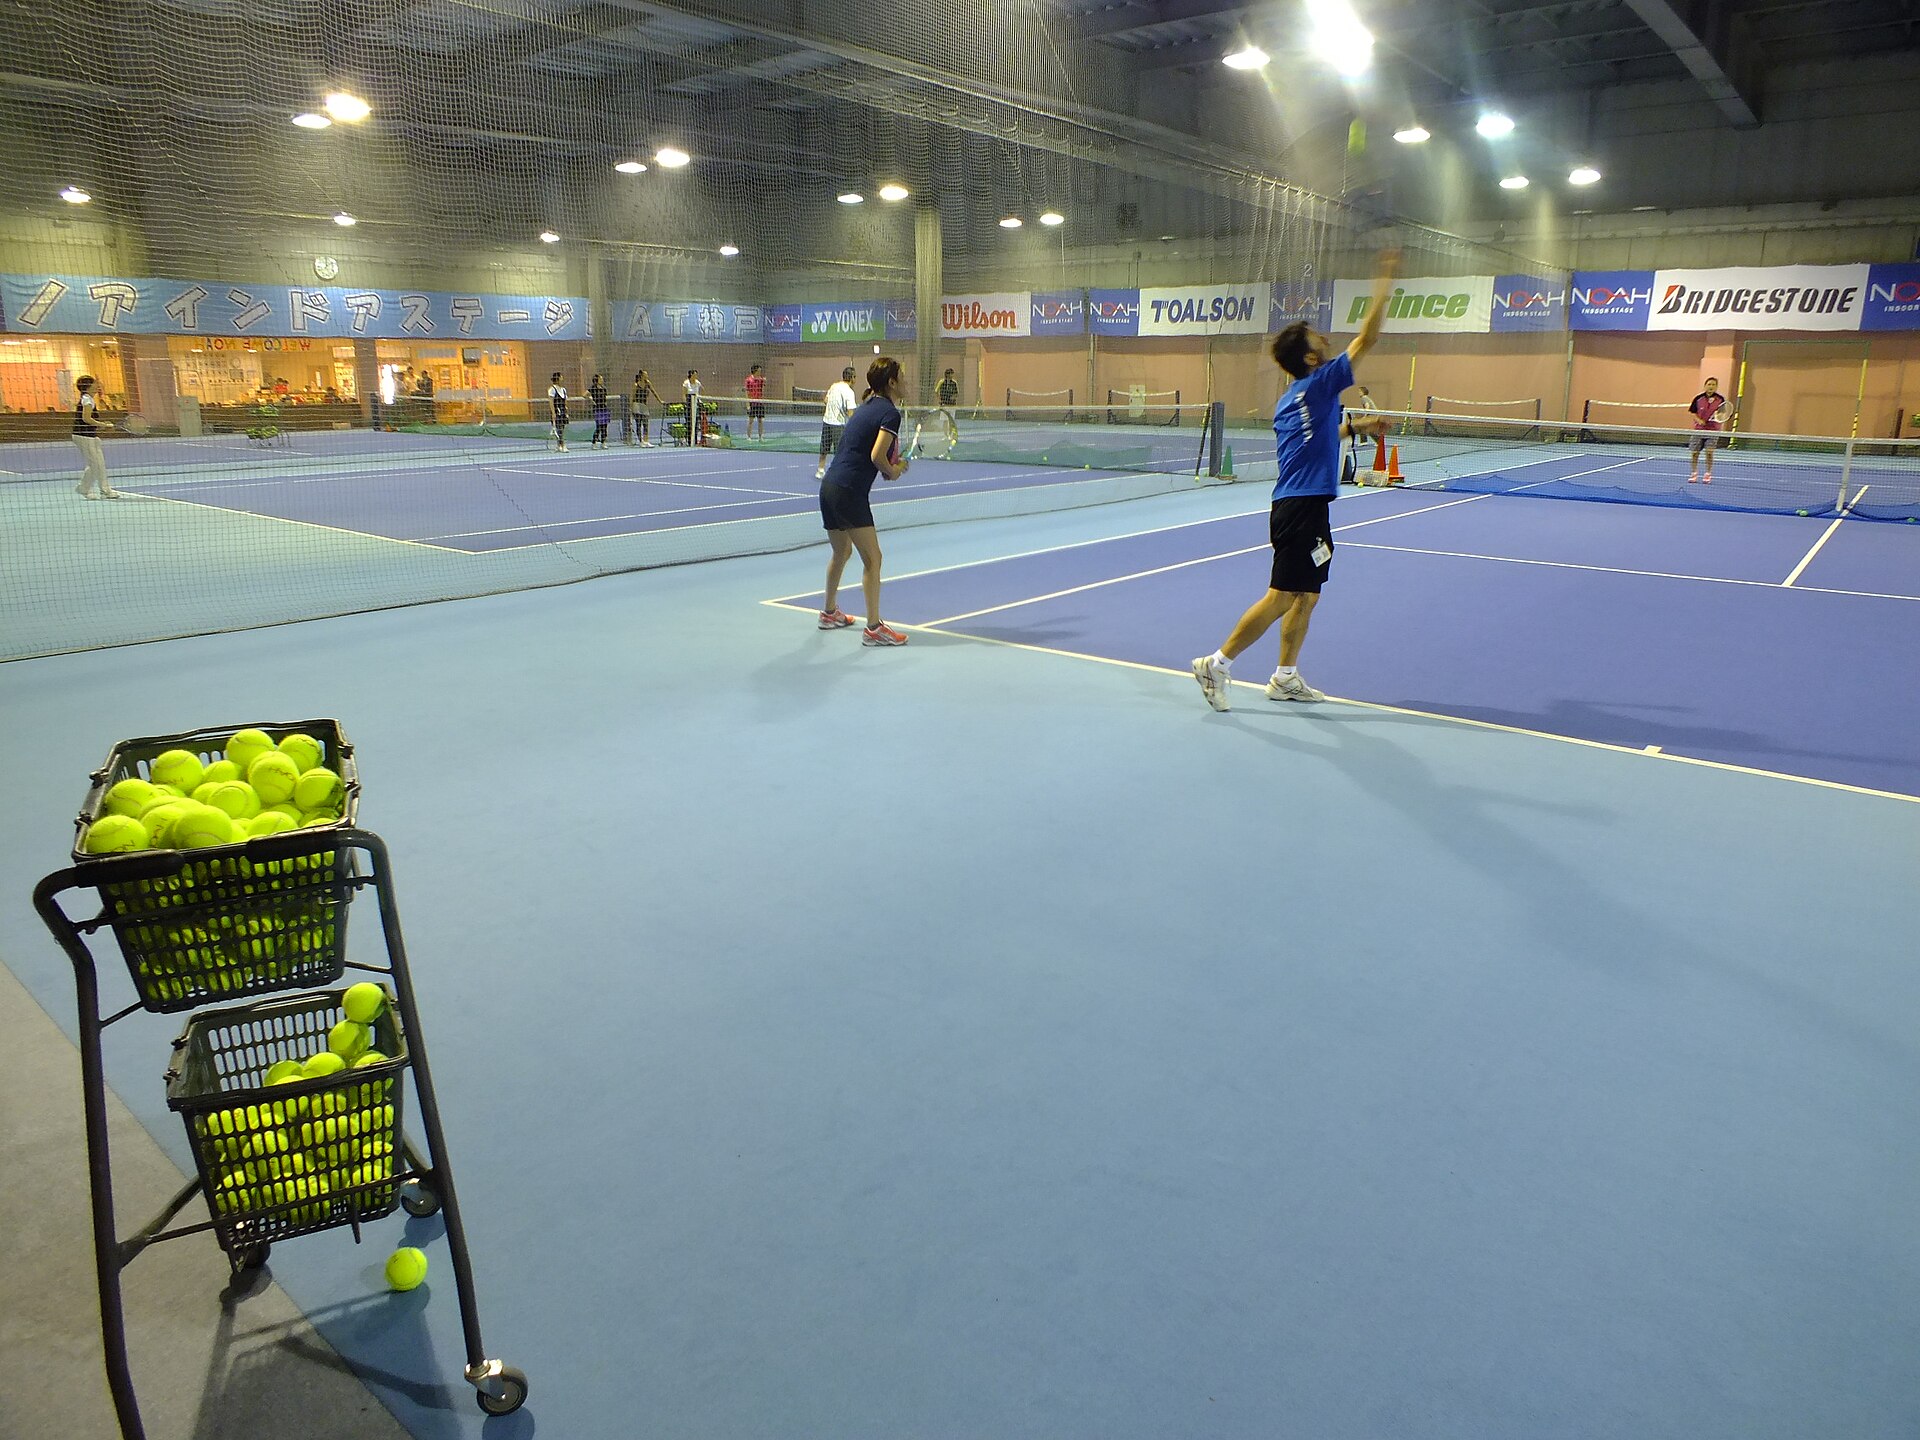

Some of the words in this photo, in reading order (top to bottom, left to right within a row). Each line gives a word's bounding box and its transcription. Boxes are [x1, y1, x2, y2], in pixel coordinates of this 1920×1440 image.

[1304, 263, 1312, 277] 2
[1270, 296, 1332, 313] NOAH
[1346, 288, 1471, 324] pince
[1492, 289, 1566, 310] NOAH
[1571, 287, 1652, 306] NOAH
[1657, 284, 1858, 315] BRIDGESTONE
[941, 301, 1017, 331] Wilson
[1032, 301, 1082, 317] NOAH
[1090, 302, 1139, 317] NOAH
[1151, 296, 1256, 323] TOALSON
[835, 309, 874, 333] YONEX
